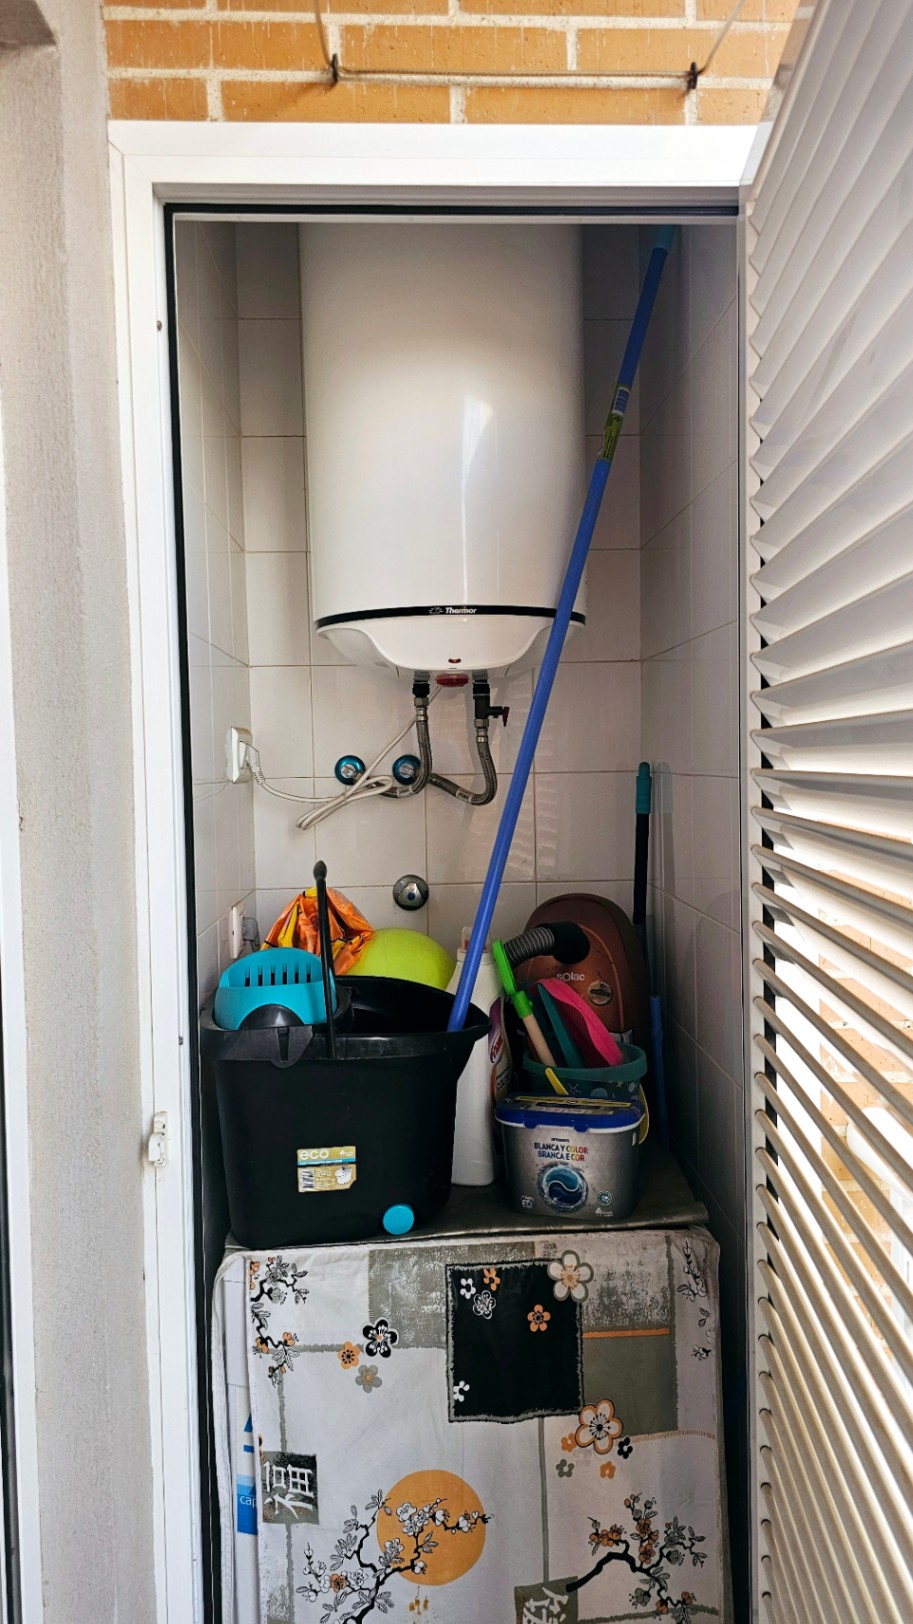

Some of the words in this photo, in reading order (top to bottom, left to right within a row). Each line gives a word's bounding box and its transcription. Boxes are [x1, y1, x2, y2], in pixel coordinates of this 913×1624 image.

[534, 1143, 560, 1151] BLANCA
[566, 1145, 588, 1154] COLOR
[300, 1150, 329, 1160] eco
[538, 1150, 565, 1160] BRANCA
